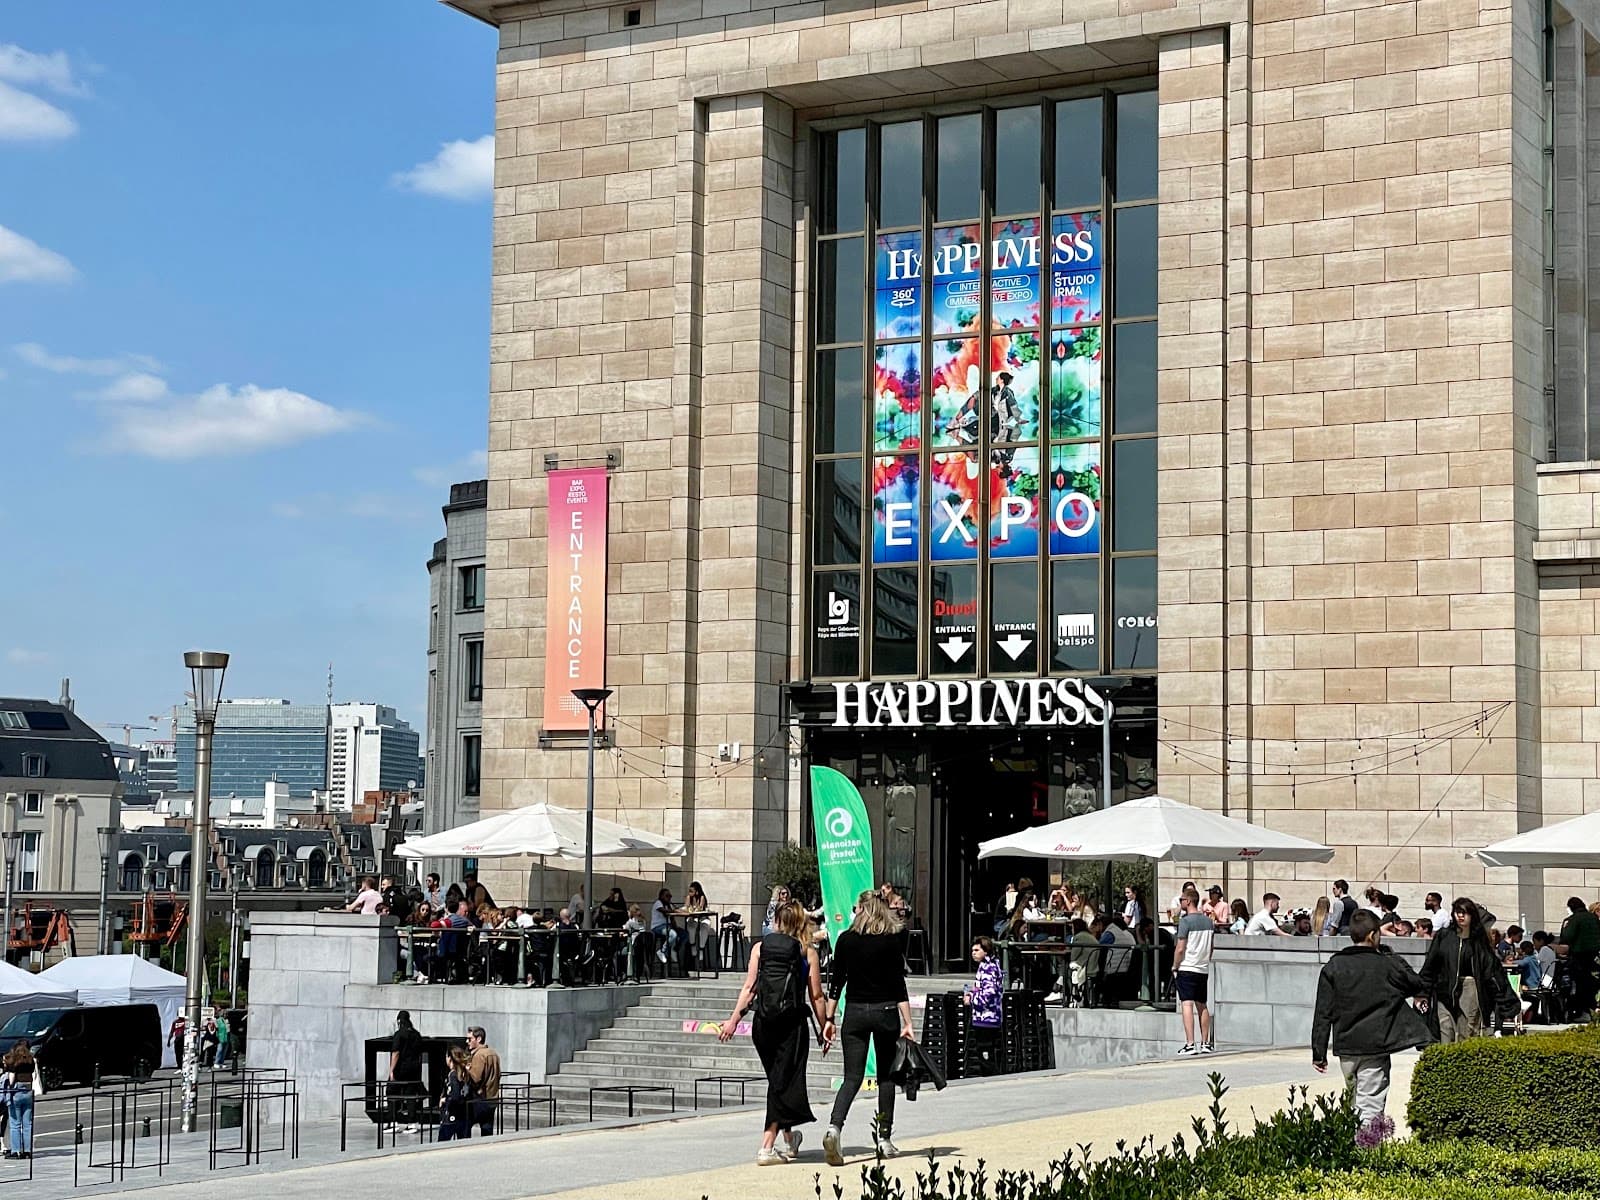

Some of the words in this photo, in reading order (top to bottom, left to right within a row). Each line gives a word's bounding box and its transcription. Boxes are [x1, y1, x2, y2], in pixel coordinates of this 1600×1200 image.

[1054, 274, 1096, 287] STUDIO
[1007, 291, 1030, 301] EXPO
[1054, 285, 1083, 297] IRMA
[885, 491, 1097, 547] EXPO
[567, 510, 584, 679] ENTRANCE
[934, 599, 977, 616] Duvel
[935, 625, 976, 634] ENTRANCE
[994, 623, 1036, 632] ENTRANCE
[1057, 636, 1095, 647] belspo
[831, 677, 1114, 728] HAPPINESS
